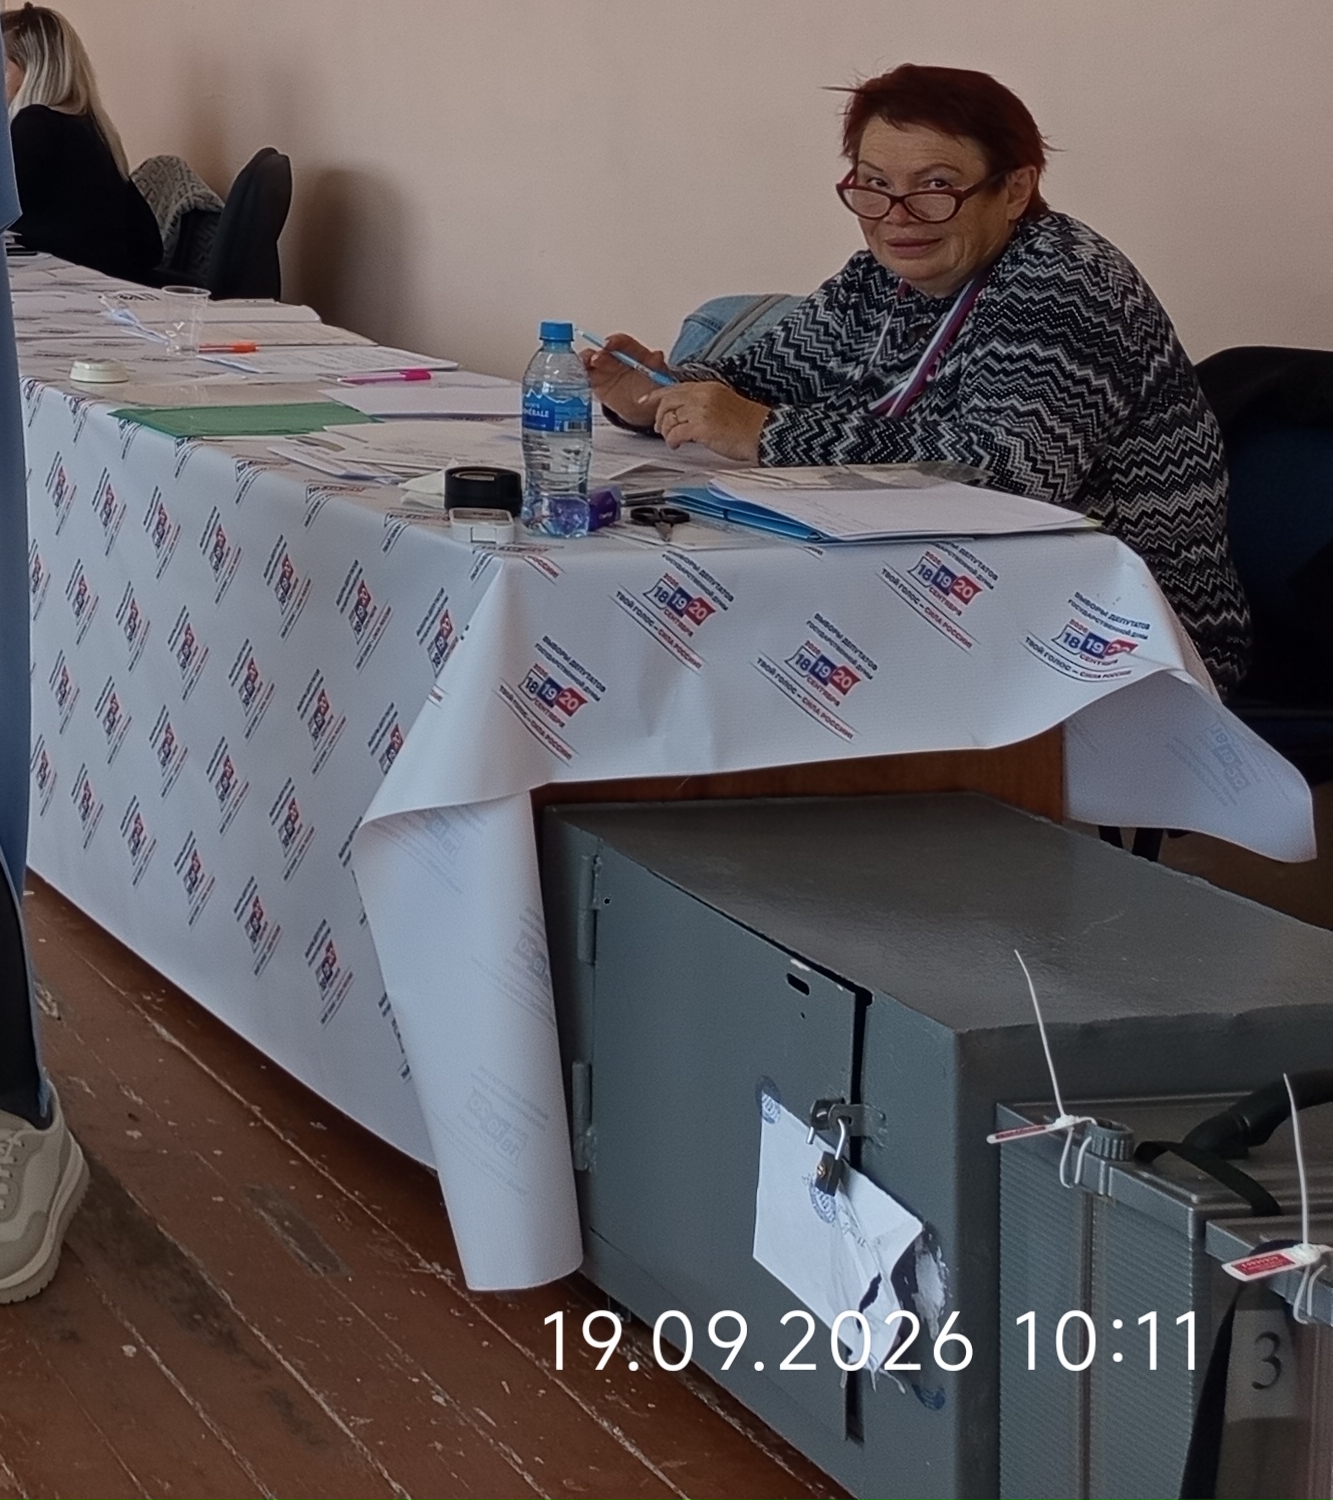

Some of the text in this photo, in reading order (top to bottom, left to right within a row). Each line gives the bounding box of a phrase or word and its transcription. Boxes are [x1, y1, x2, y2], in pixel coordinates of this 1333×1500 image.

[918, 564, 973, 598] 18 19 20
[959, 548, 998, 581] ДЕПУТАТОВ
[699, 570, 734, 602] ДЕПУТАТОВ
[976, 574, 994, 590] ДУМЫ
[653, 586, 707, 620] 18 19 20
[712, 596, 728, 611] ДУМЫ
[882, 568, 973, 649] ТВОЙ ГОЛОС СИЛА РОССИИ!
[929, 587, 962, 616] СЕНТЯБРЯ
[1074, 591, 1151, 630] ВЫБОРЫ ДЕПУТАТОВ
[616, 591, 702, 669] ТВОЙ ГОЛОС СИЛА РОССИИ!
[664, 608, 694, 637] СЕНТЯБРЯ
[1130, 632, 1148, 640] ДУМЫ
[814, 613, 878, 670] ВЫБОРЫ ДЕПУТАТОВ
[1026, 636, 1044, 655] ТВОЙ
[1043, 652, 1071, 671] ГОЛОС
[1080, 671, 1101, 679] СИЛА
[1065, 632, 1081, 649] 18
[1086, 640, 1105, 654] 19
[795, 653, 852, 689] 18 19 20
[856, 664, 873, 680] ДУМЫ
[757, 657, 853, 739] ТВОЙ ГОЛОС СИЛА РОССИИ!
[807, 676, 840, 707] СЕНТЯБРЯ
[1252, 1332, 1282, 1389] 3
